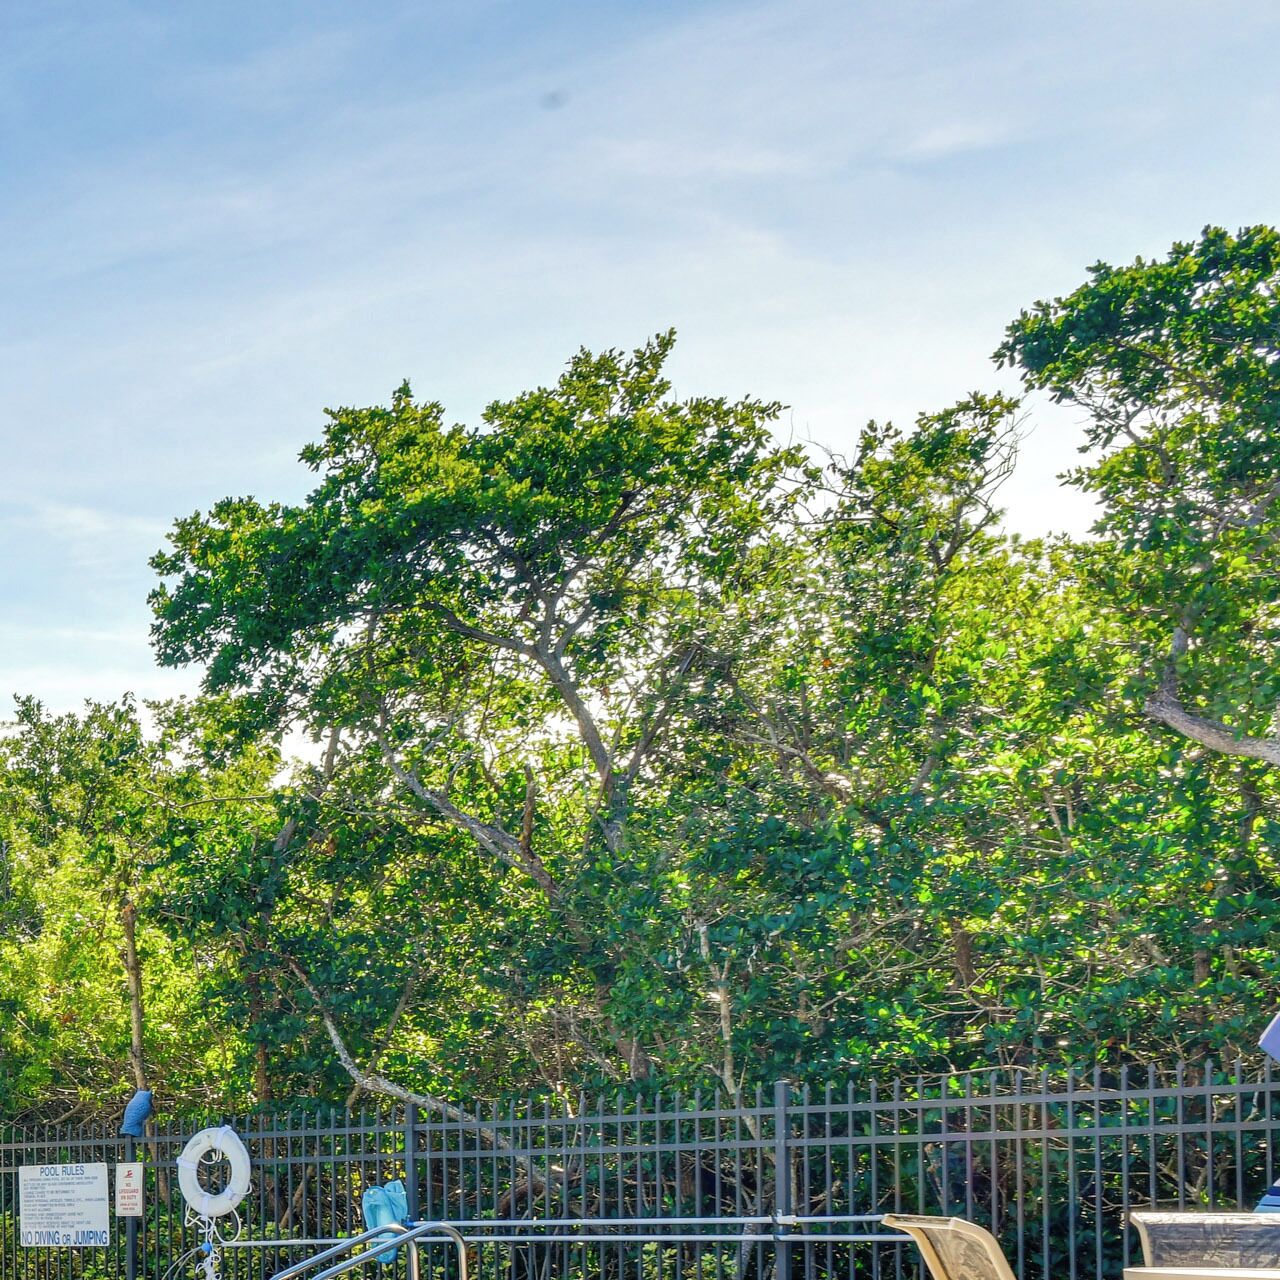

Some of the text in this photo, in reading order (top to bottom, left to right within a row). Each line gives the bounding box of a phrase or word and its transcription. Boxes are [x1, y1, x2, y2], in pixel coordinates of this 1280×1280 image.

[40, 1165, 85, 1177] POOL RULES
[22, 1230, 108, 1245] NO DIVING OR JUMPING
